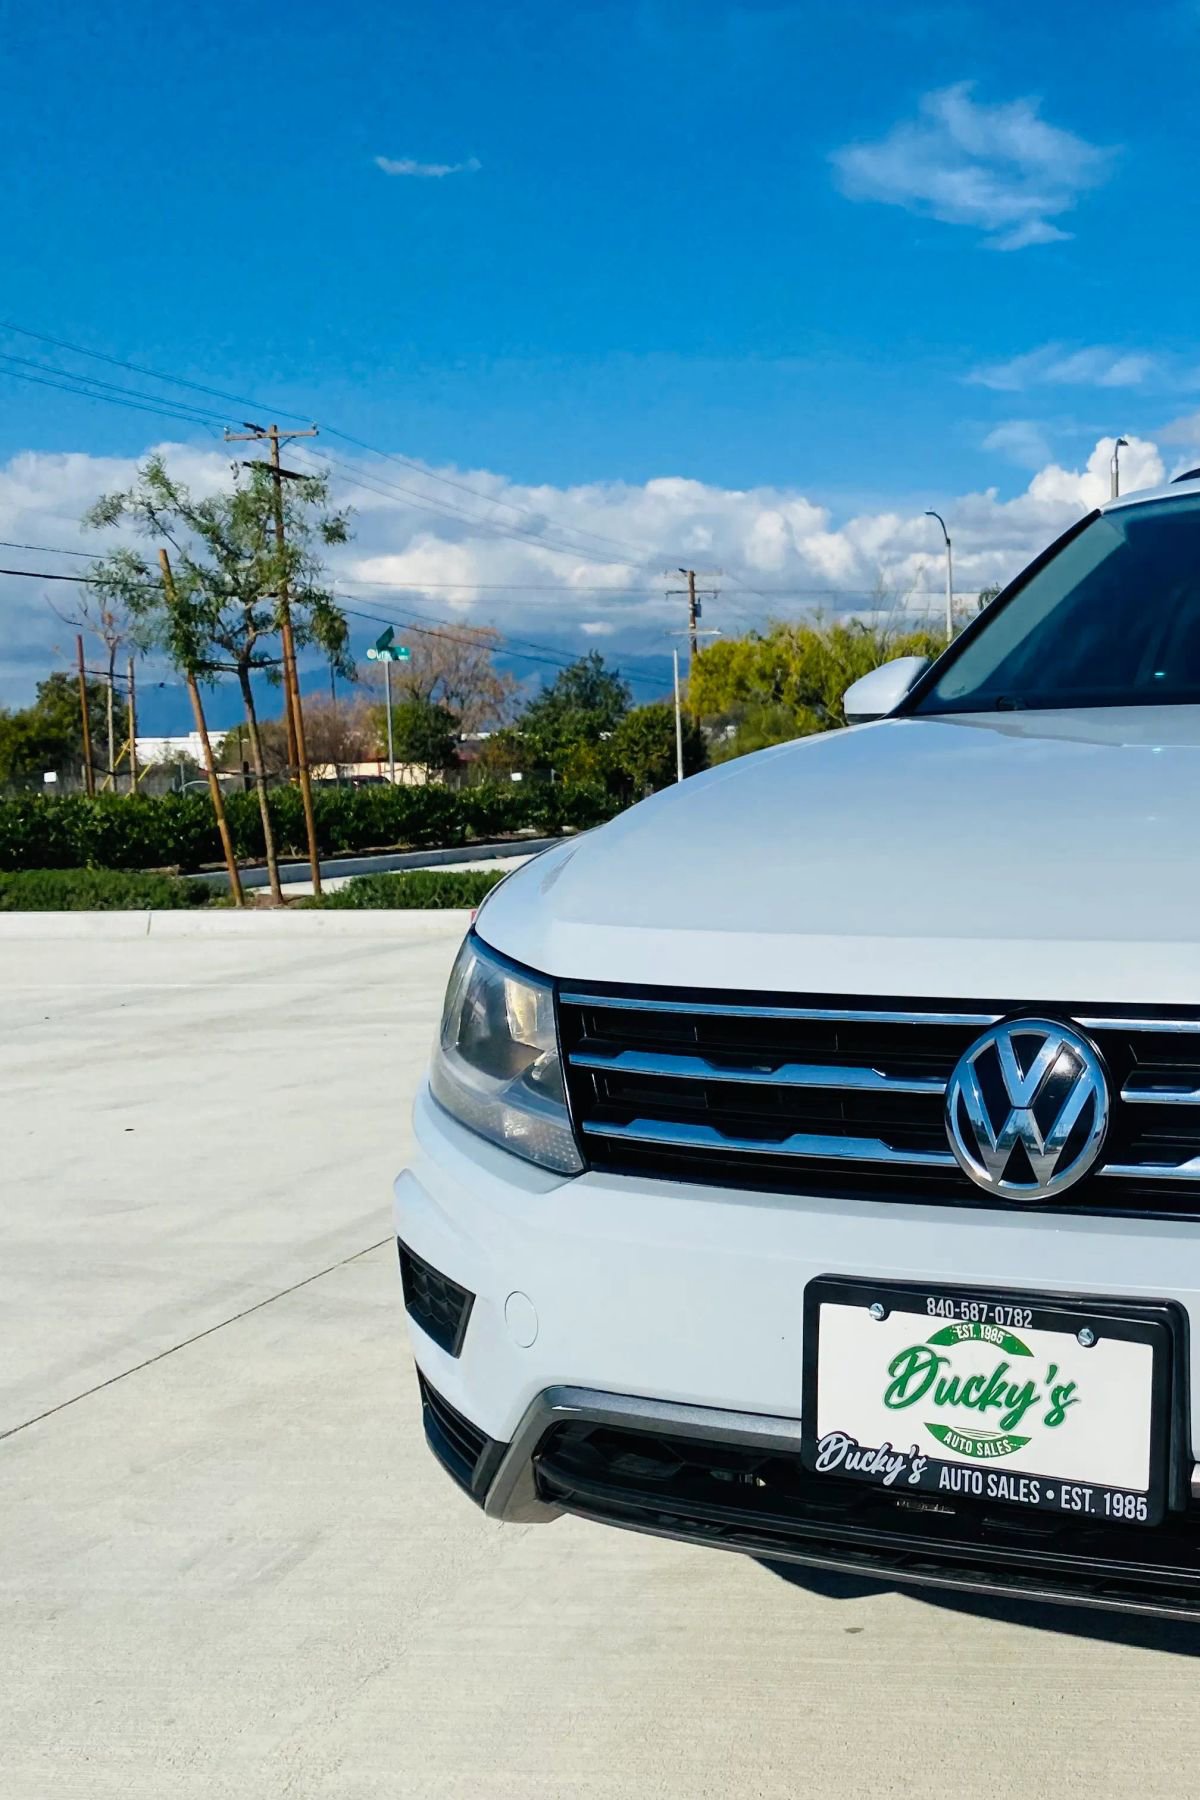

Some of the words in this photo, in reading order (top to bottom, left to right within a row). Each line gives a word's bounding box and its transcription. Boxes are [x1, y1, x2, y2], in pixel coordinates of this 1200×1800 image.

[926, 1297, 1033, 1329] 840-587-0782
[956, 1323, 977, 1339] EST.
[980, 1324, 1005, 1344] 1985
[884, 1345, 1081, 1432] Ducky's
[943, 1431, 973, 1454] AUTO
[976, 1439, 1012, 1457] SALES
[815, 1433, 928, 1486] Ducky's
[939, 1466, 983, 1496] AUTO
[987, 1474, 1041, 1504] SALES
[1060, 1485, 1096, 1514] EST.
[1103, 1492, 1149, 1522] 1985
